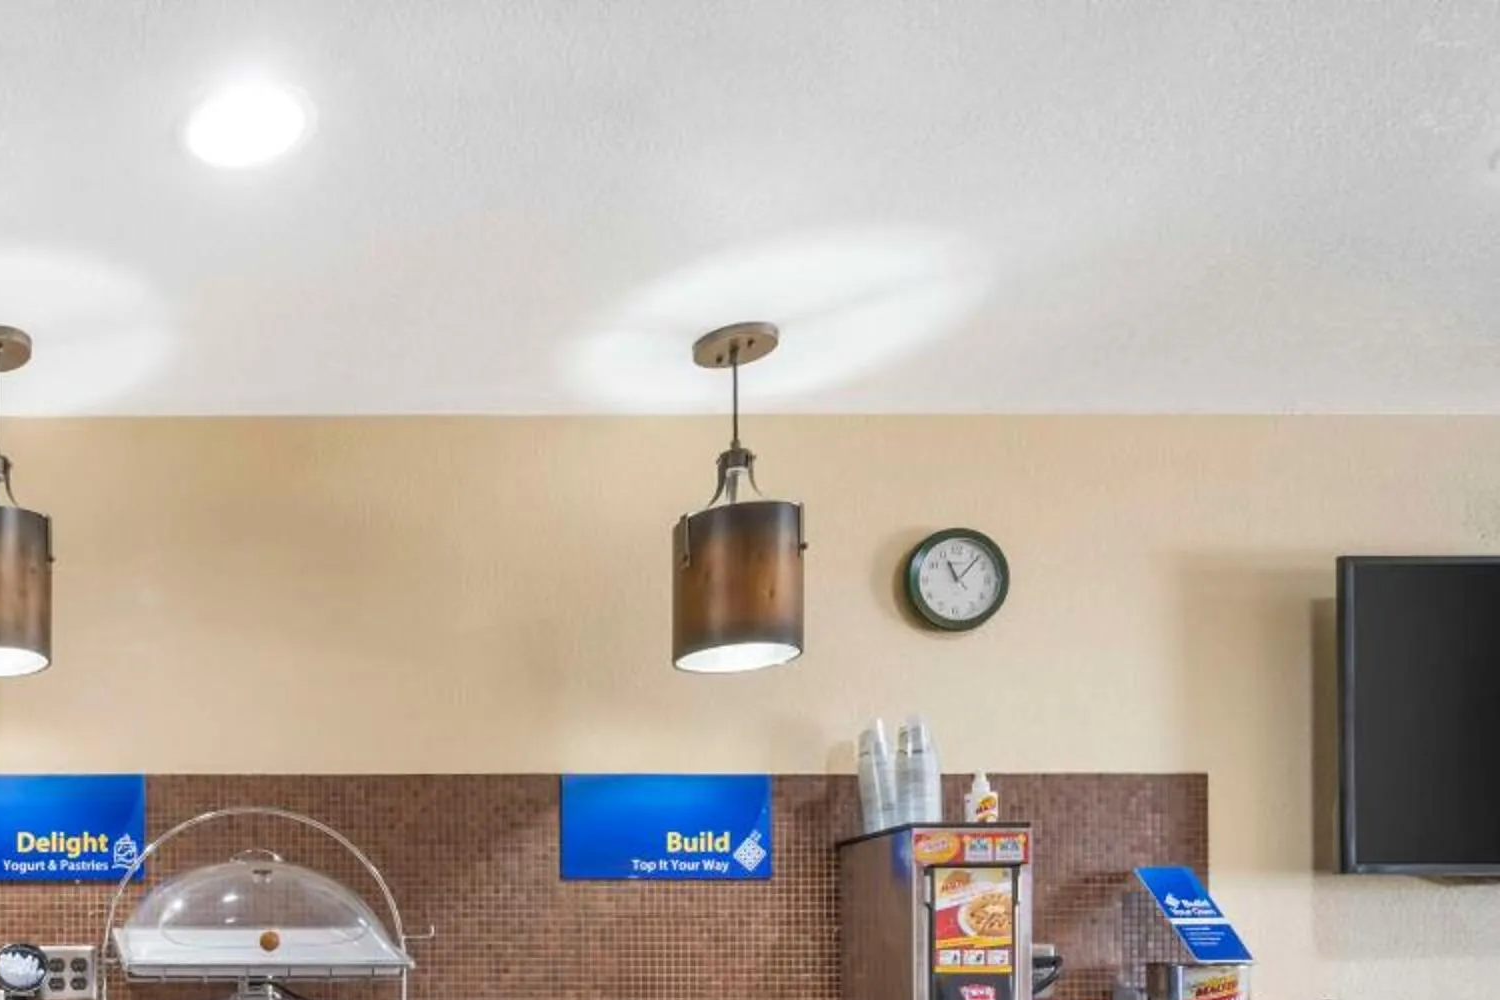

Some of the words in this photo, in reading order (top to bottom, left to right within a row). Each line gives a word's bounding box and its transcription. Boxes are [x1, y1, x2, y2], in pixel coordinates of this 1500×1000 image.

[16, 831, 108, 858] Delight
[666, 831, 731, 853] Build
[3, 859, 45, 874] Yogurt
[47, 860, 57, 871] &
[59, 859, 109, 871] Pastries
[631, 859, 657, 873] Top
[659, 859, 669, 871] It
[671, 859, 700, 871] Your
[701, 859, 730, 873] Way
